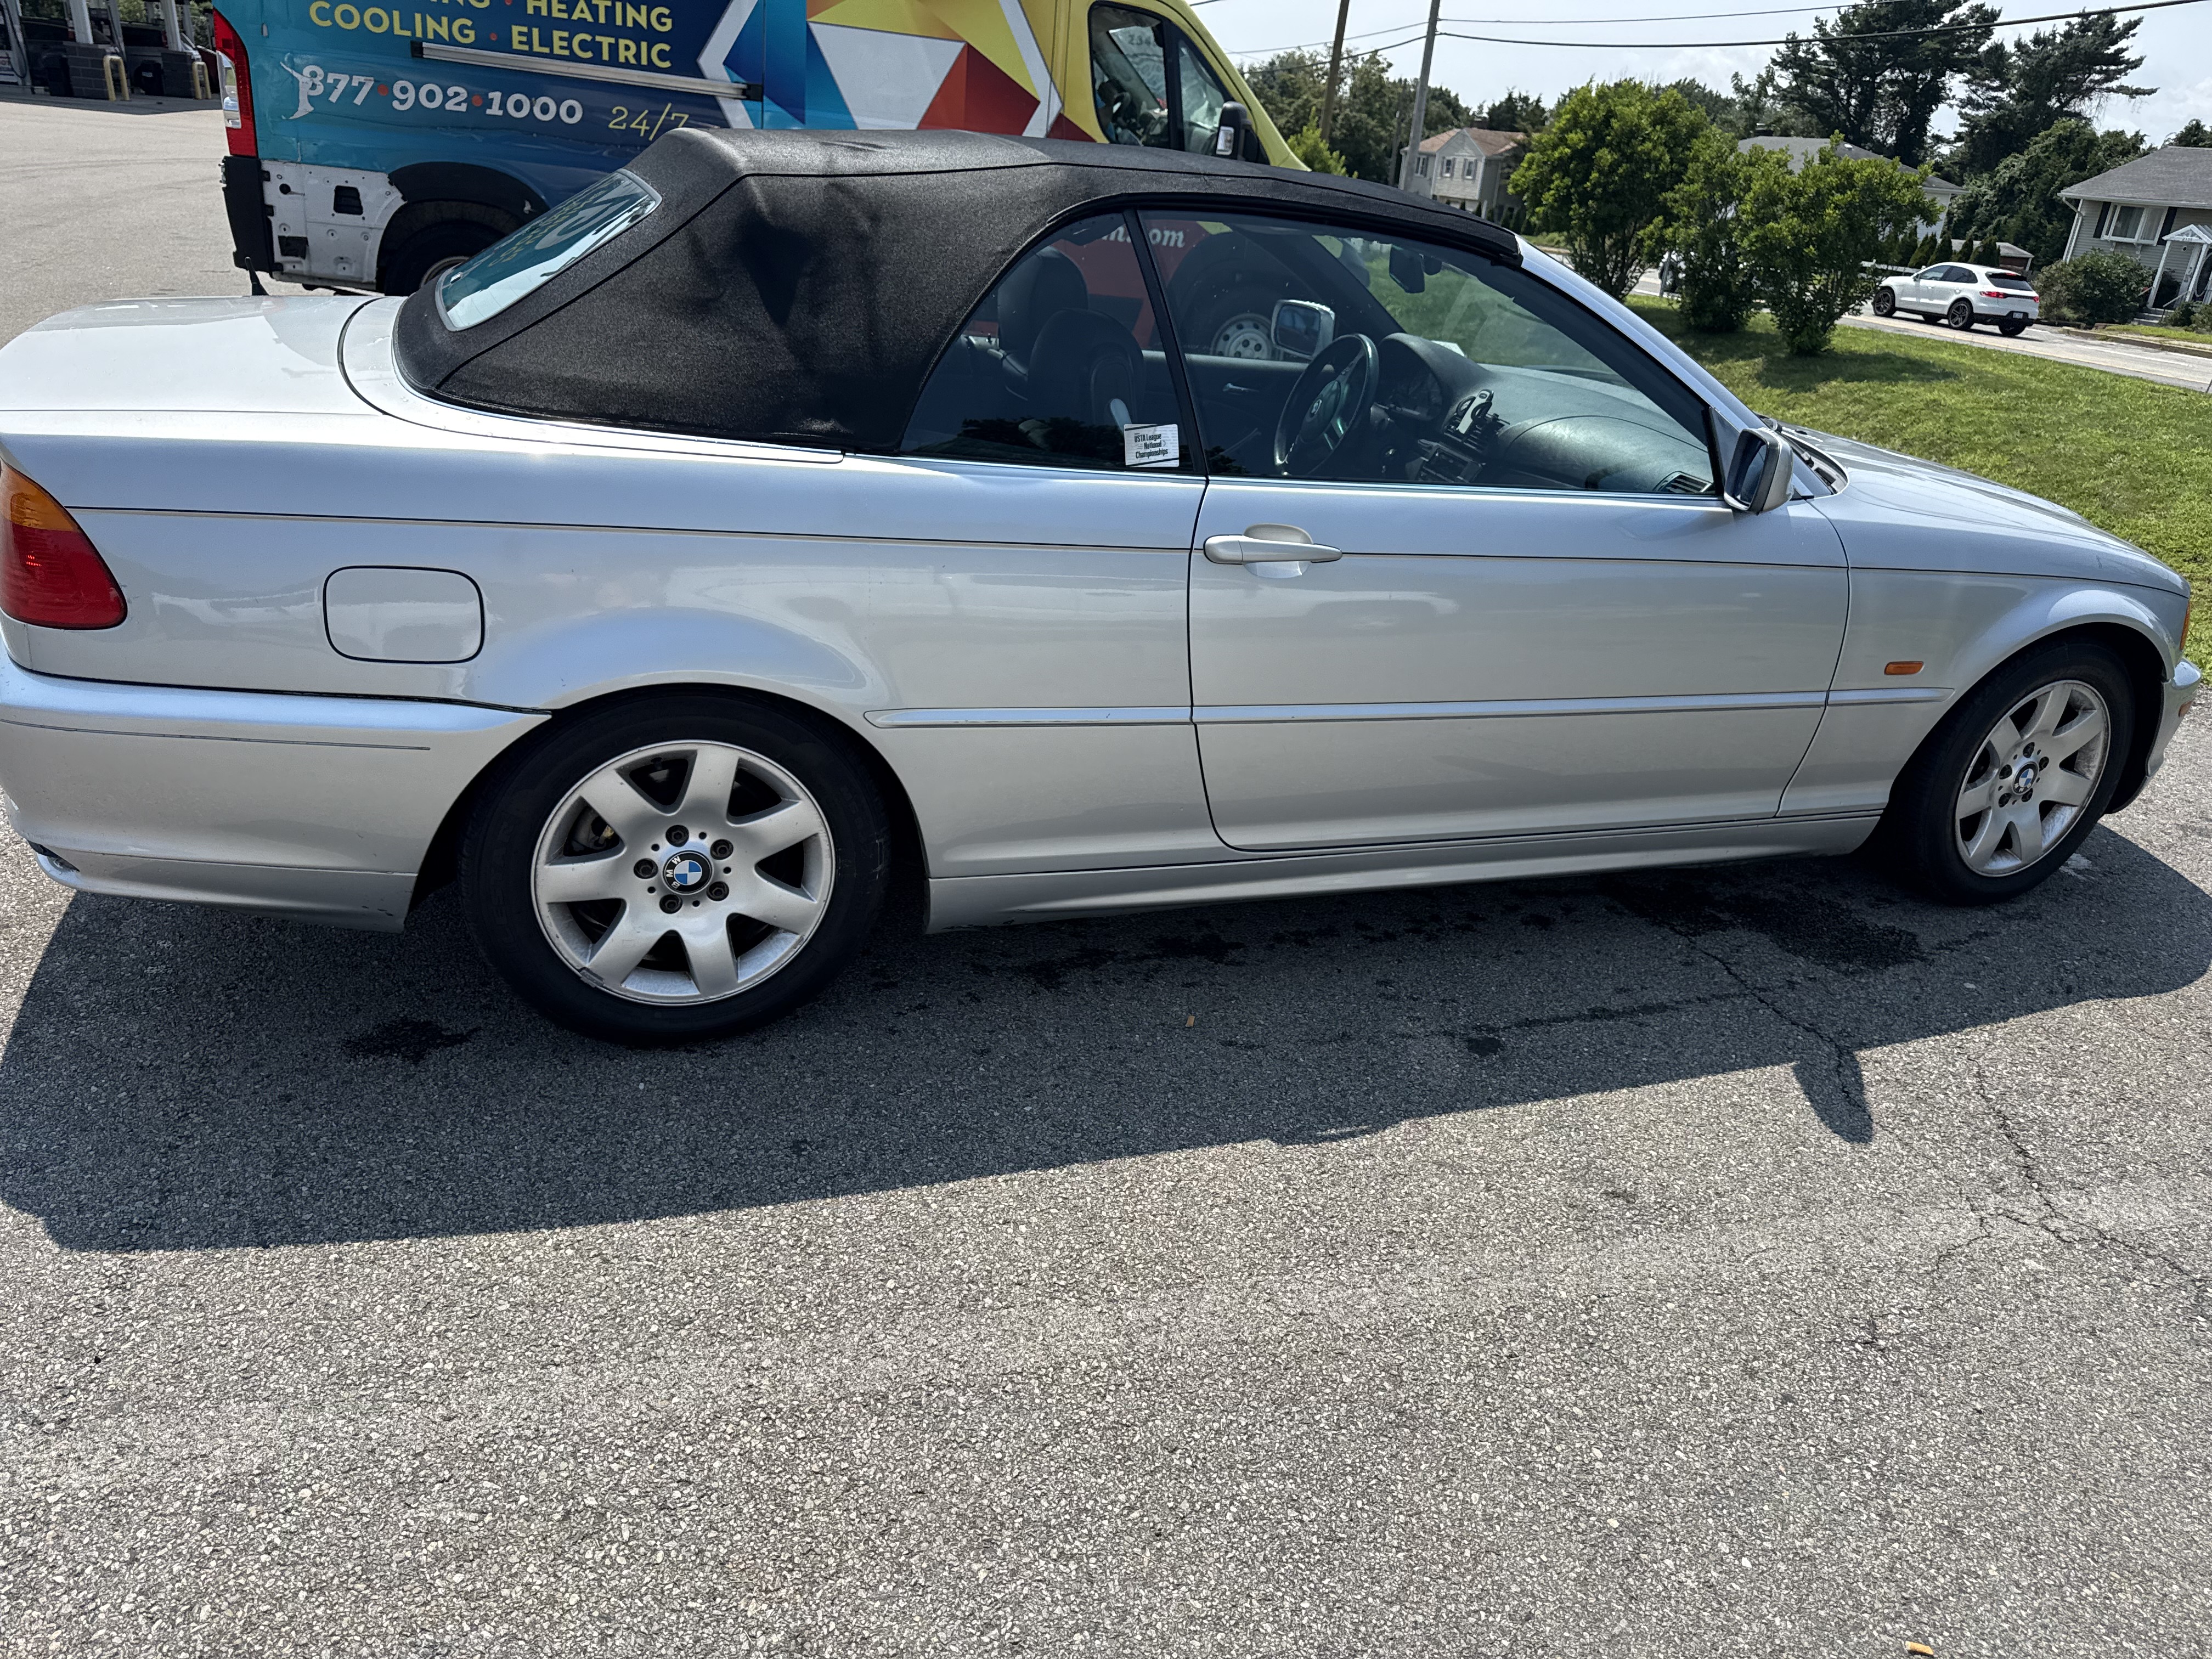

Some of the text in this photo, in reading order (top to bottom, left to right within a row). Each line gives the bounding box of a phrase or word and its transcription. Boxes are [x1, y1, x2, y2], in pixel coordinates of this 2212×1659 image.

[526, 0, 673, 32] HEATING
[309, 1, 672, 68] COOLING ELECTRIC
[1134, 434, 1146, 443] USTA
[1144, 439, 1162, 450] National
[1135, 448, 1169, 459] Championships
[665, 856, 681, 889] BMW
